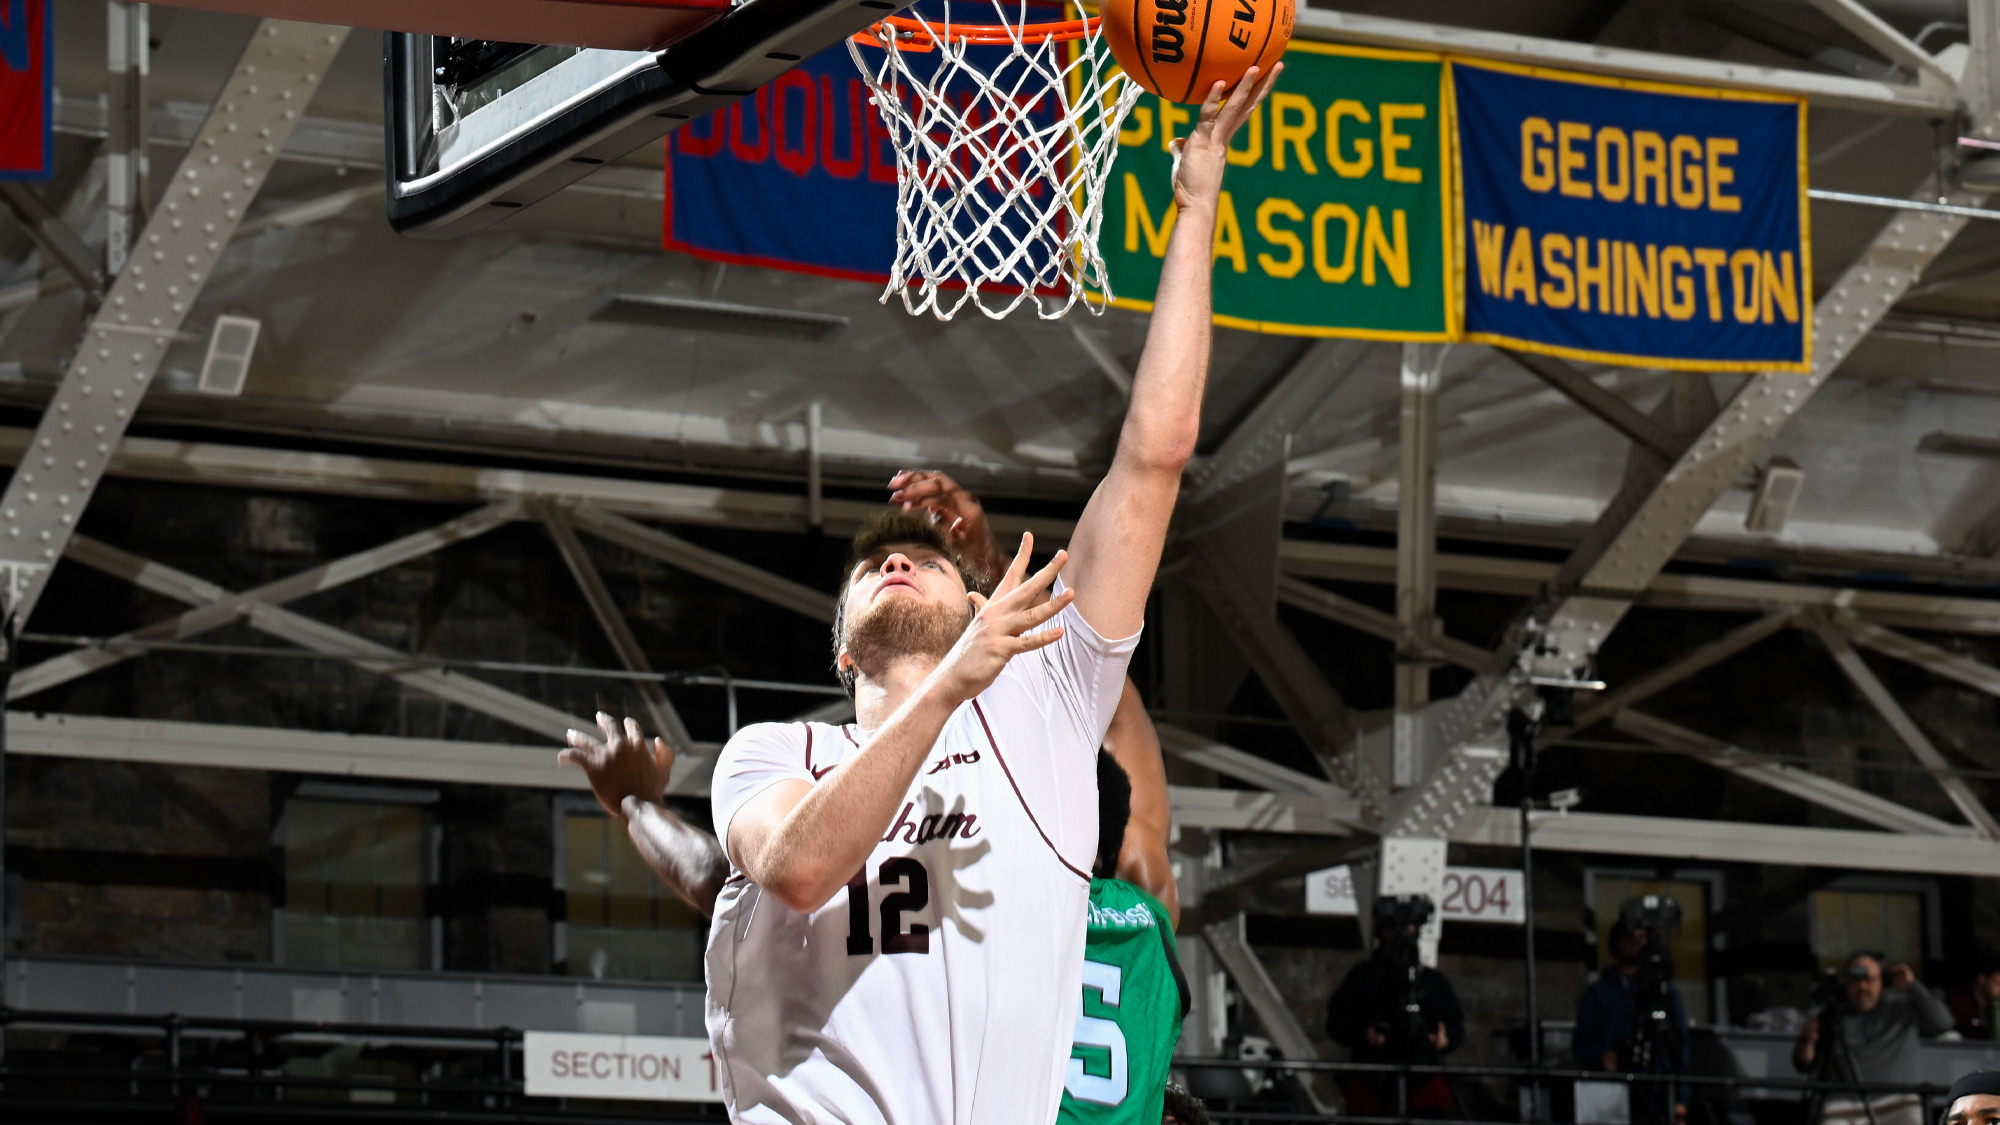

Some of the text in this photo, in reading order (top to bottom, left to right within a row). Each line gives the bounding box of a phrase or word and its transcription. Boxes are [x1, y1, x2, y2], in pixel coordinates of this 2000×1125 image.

[1152, 0, 1189, 64] Wil
[1228, 0, 1257, 51] EV
[1520, 116, 1742, 213] GEORGE
[1123, 172, 1411, 288] MASON
[1471, 219, 1800, 325] WASHINGTON
[879, 801, 982, 845] ham
[846, 856, 930, 956] 12
[1324, 872, 1511, 915] SE 204
[551, 1050, 682, 1082] SECTION
[1064, 958, 1129, 1109] 5
